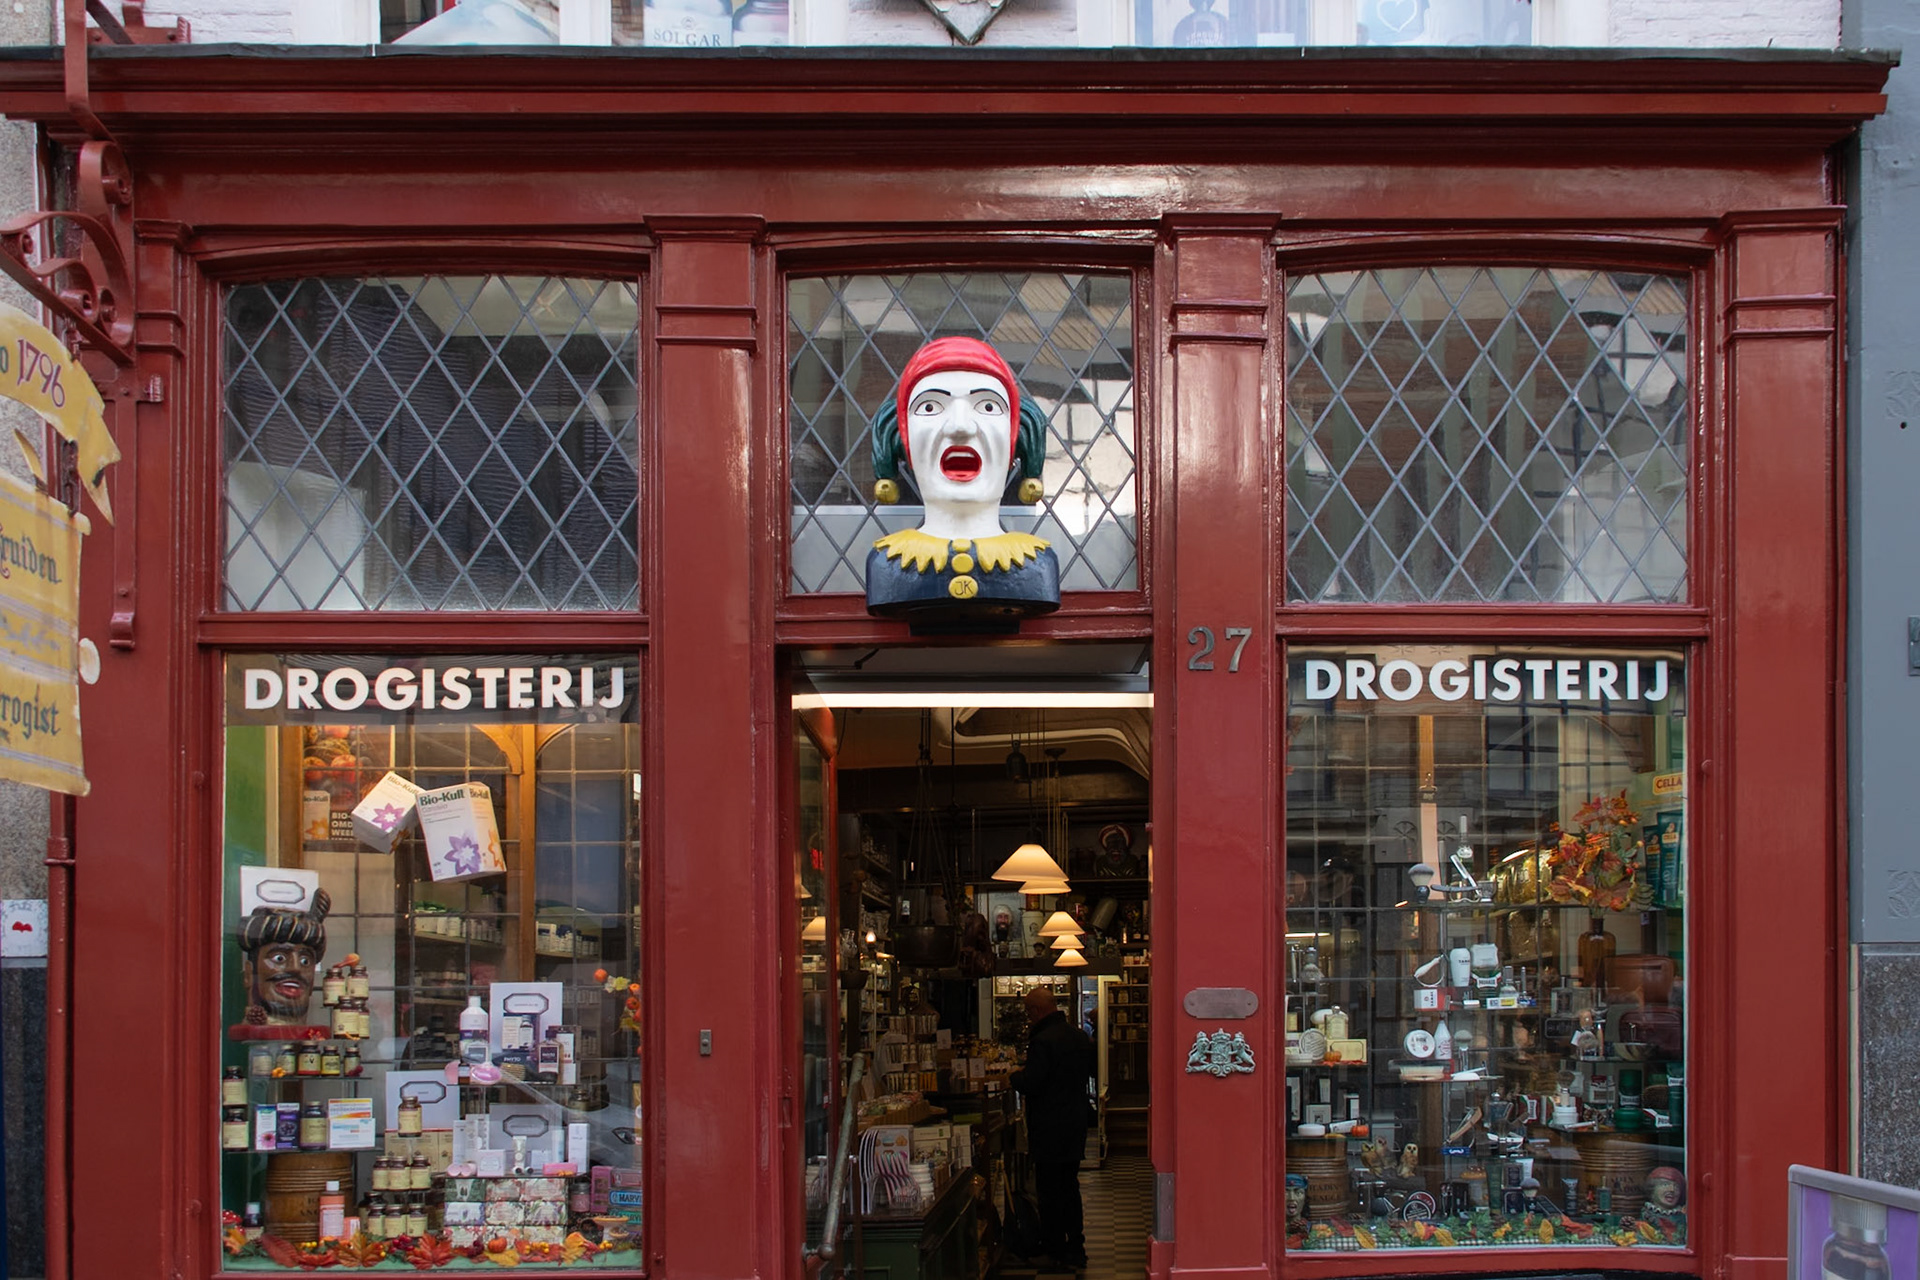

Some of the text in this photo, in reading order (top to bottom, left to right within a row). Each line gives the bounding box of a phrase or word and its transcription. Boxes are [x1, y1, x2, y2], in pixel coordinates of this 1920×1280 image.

[653, 28, 721, 46] SOLGAR
[17, 338, 66, 408] 1796
[955, 580, 971, 595] JK
[1188, 626, 1253, 671] 27
[244, 667, 625, 711] DROGISTERIJ
[1305, 659, 1669, 701] DROGISTERIJ
[419, 789, 465, 806] Bio-Kult
